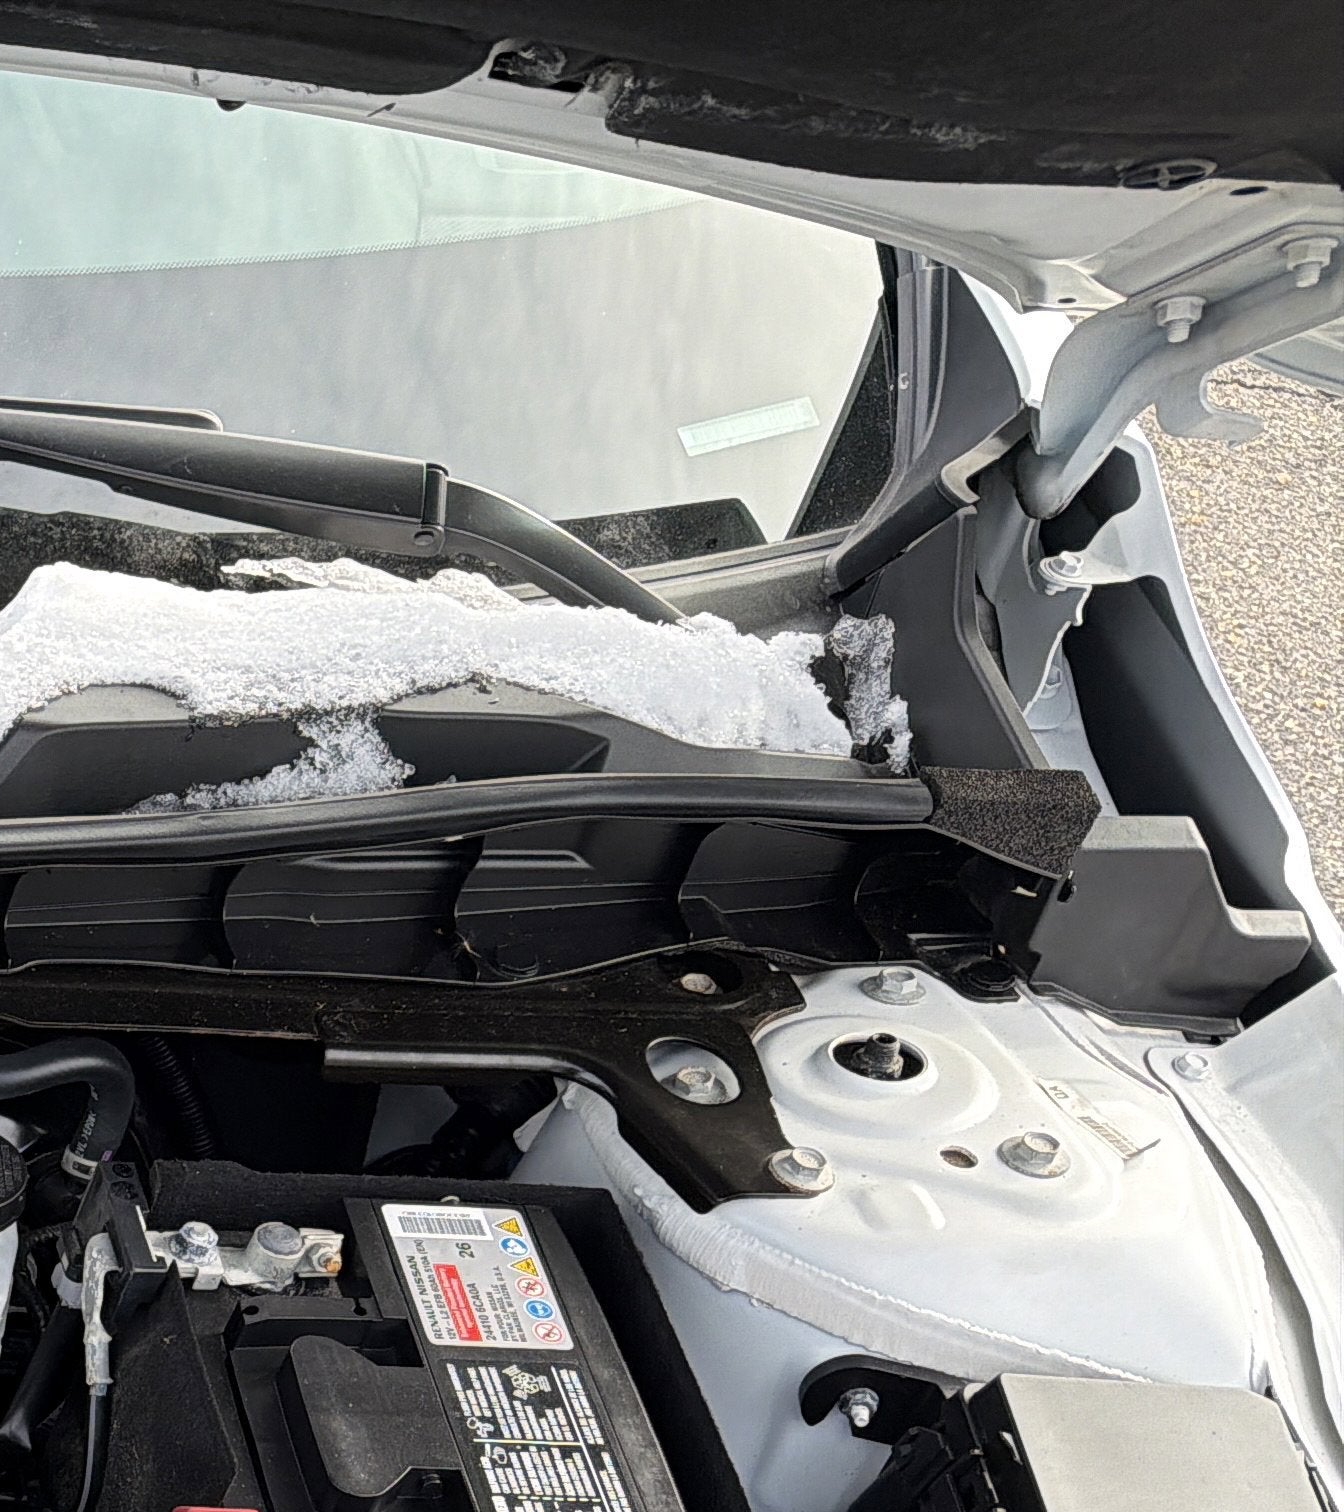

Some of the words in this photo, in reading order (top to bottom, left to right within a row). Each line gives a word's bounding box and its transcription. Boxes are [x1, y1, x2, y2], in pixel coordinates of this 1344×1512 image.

[456, 1242, 476, 1259] 26
[406, 1255, 429, 1296] NISSAN
[434, 1294, 446, 1308] EFB
[422, 1300, 445, 1340] RENAULT
[479, 1314, 498, 1341] 24410
[446, 1328, 458, 1340] 12V
